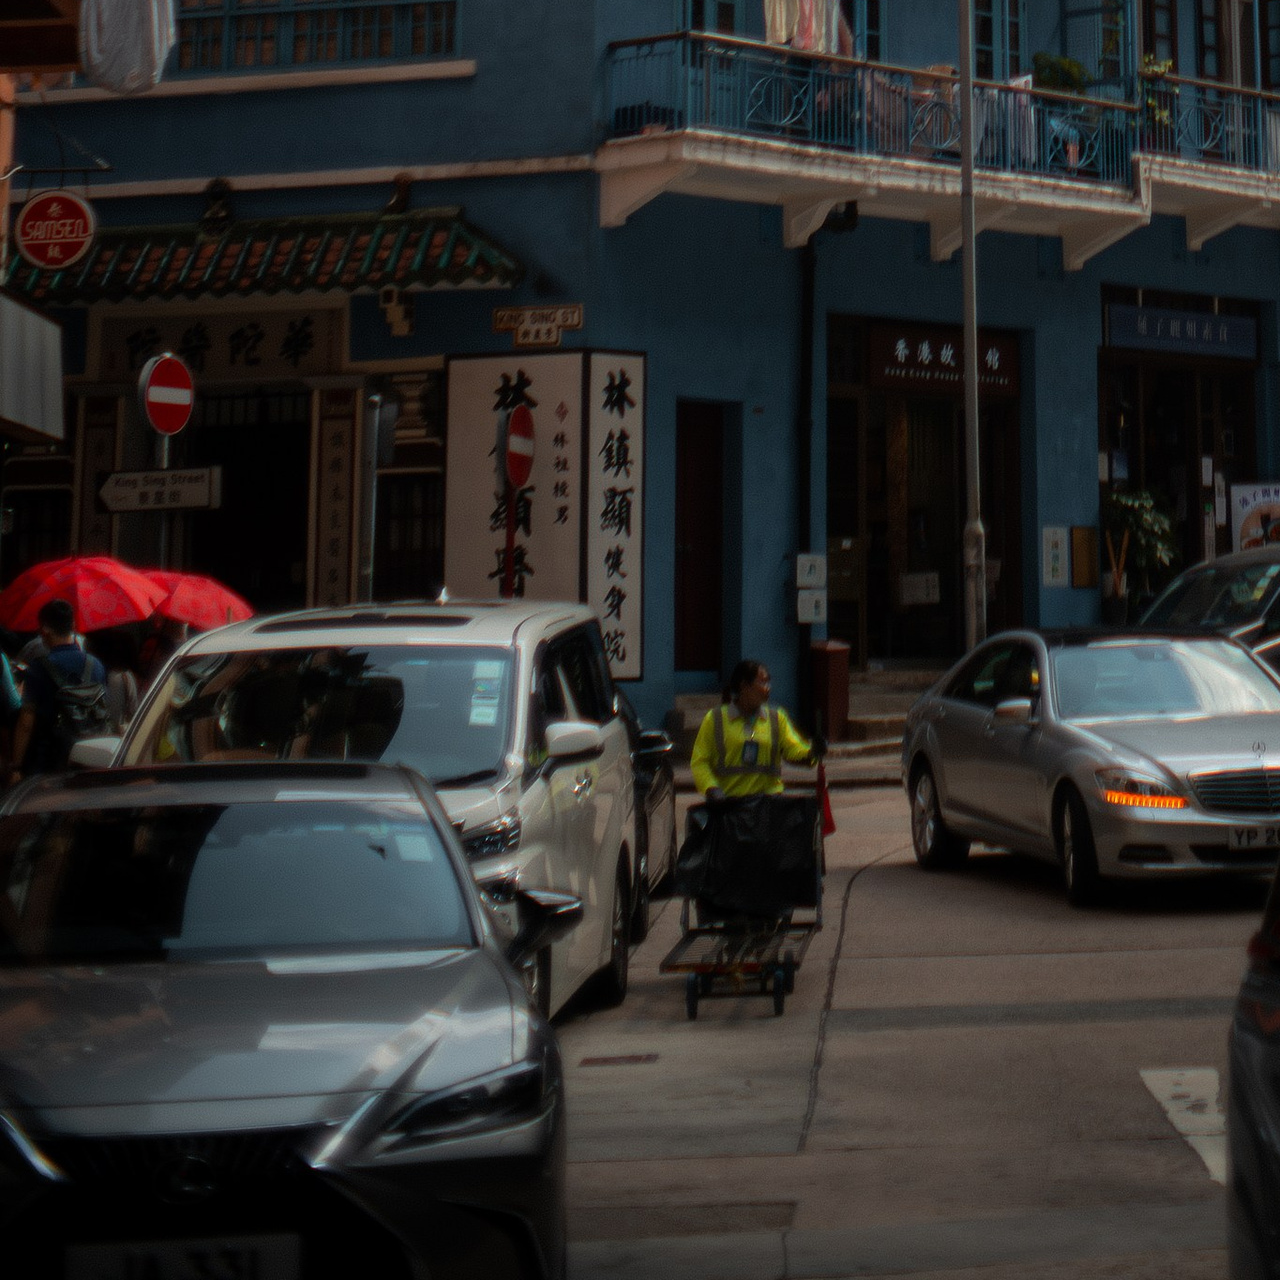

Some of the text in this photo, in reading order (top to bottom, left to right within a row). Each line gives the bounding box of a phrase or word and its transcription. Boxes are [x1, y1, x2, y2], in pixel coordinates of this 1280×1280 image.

[894, 337, 1001, 371] 香港故館
[171, 473, 205, 485] Street
